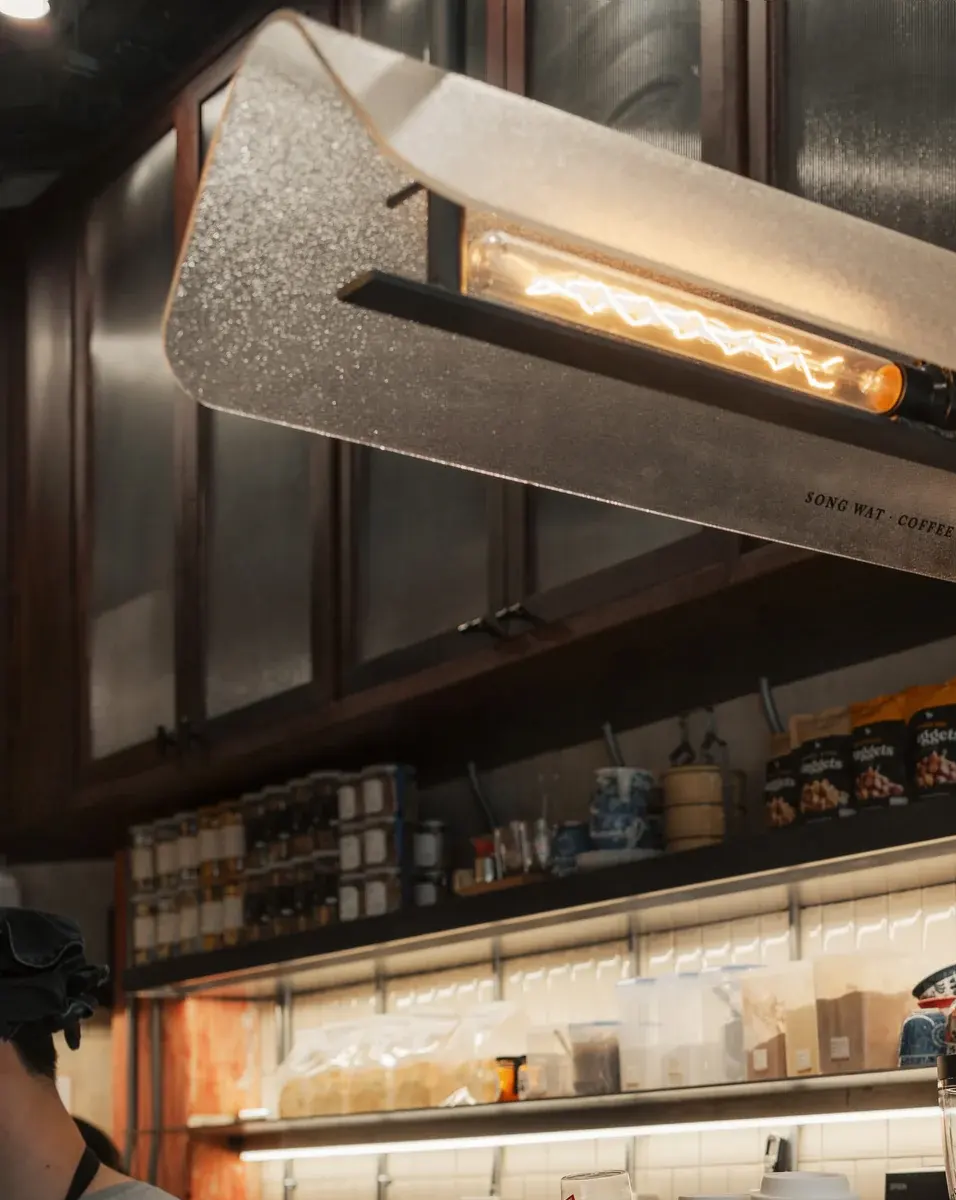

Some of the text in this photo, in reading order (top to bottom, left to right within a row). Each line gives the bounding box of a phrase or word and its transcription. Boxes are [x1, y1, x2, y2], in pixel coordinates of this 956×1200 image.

[805, 491, 848, 512] SONG
[854, 503, 885, 520] WAT
[898, 514, 954, 538] COFFEE
